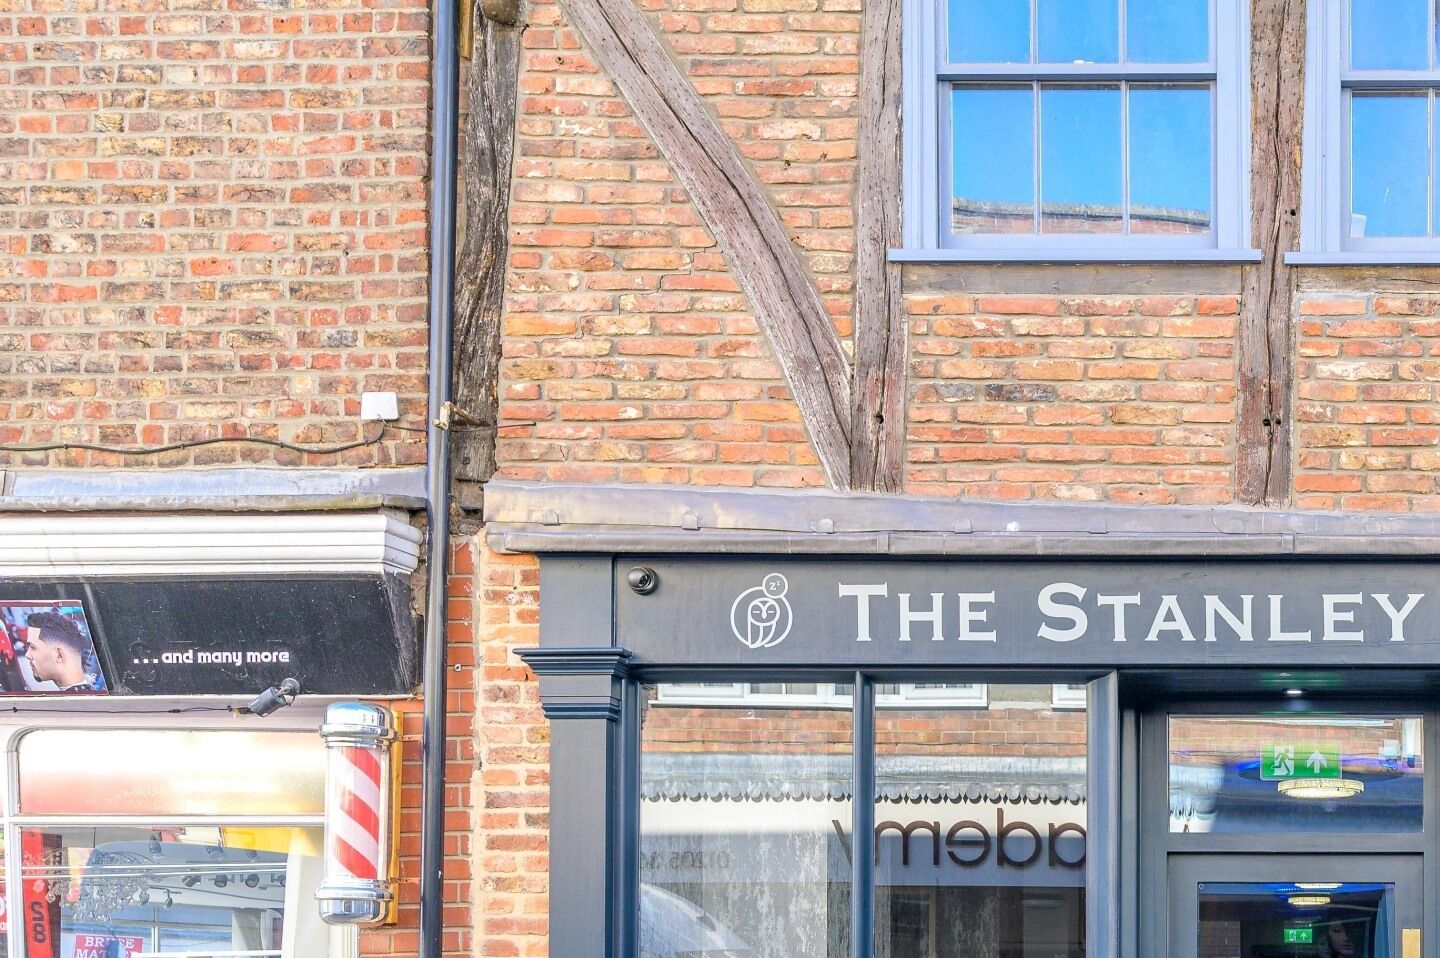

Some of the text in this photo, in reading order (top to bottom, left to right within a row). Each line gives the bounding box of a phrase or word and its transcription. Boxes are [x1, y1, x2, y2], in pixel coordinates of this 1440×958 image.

[838, 581, 997, 642] THE
[1036, 582, 1425, 642] STANLEY
[197, 651, 242, 667] many
[246, 651, 290, 663] more
[84, 936, 135, 948] BRE
